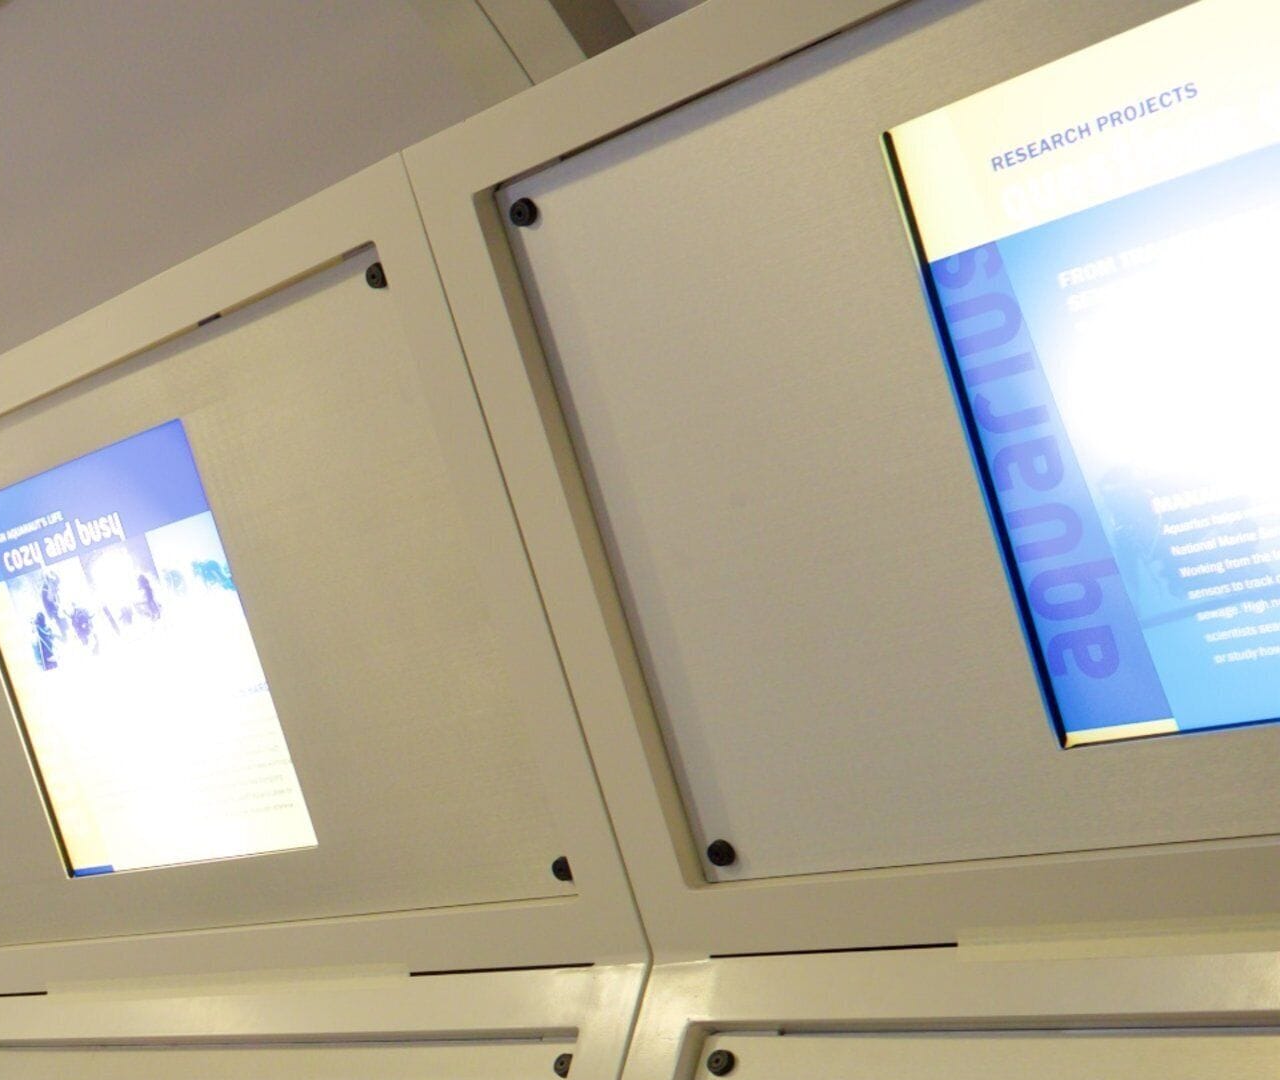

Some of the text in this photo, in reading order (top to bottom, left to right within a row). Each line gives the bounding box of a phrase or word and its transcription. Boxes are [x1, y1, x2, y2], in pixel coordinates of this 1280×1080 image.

[990, 82, 1199, 172] RESEARCH PROJECTS
[46, 510, 64, 526] LIFE
[3, 511, 127, 574] cozy and busy
[1170, 538, 1218, 557] National
[1218, 531, 1257, 549] Marine
[1178, 551, 1272, 578] Working from the
[1188, 574, 1273, 600] sensors to track
[1243, 600, 1268, 614] High
[1204, 626, 1258, 642] scientists
[1227, 648, 1258, 663] study
